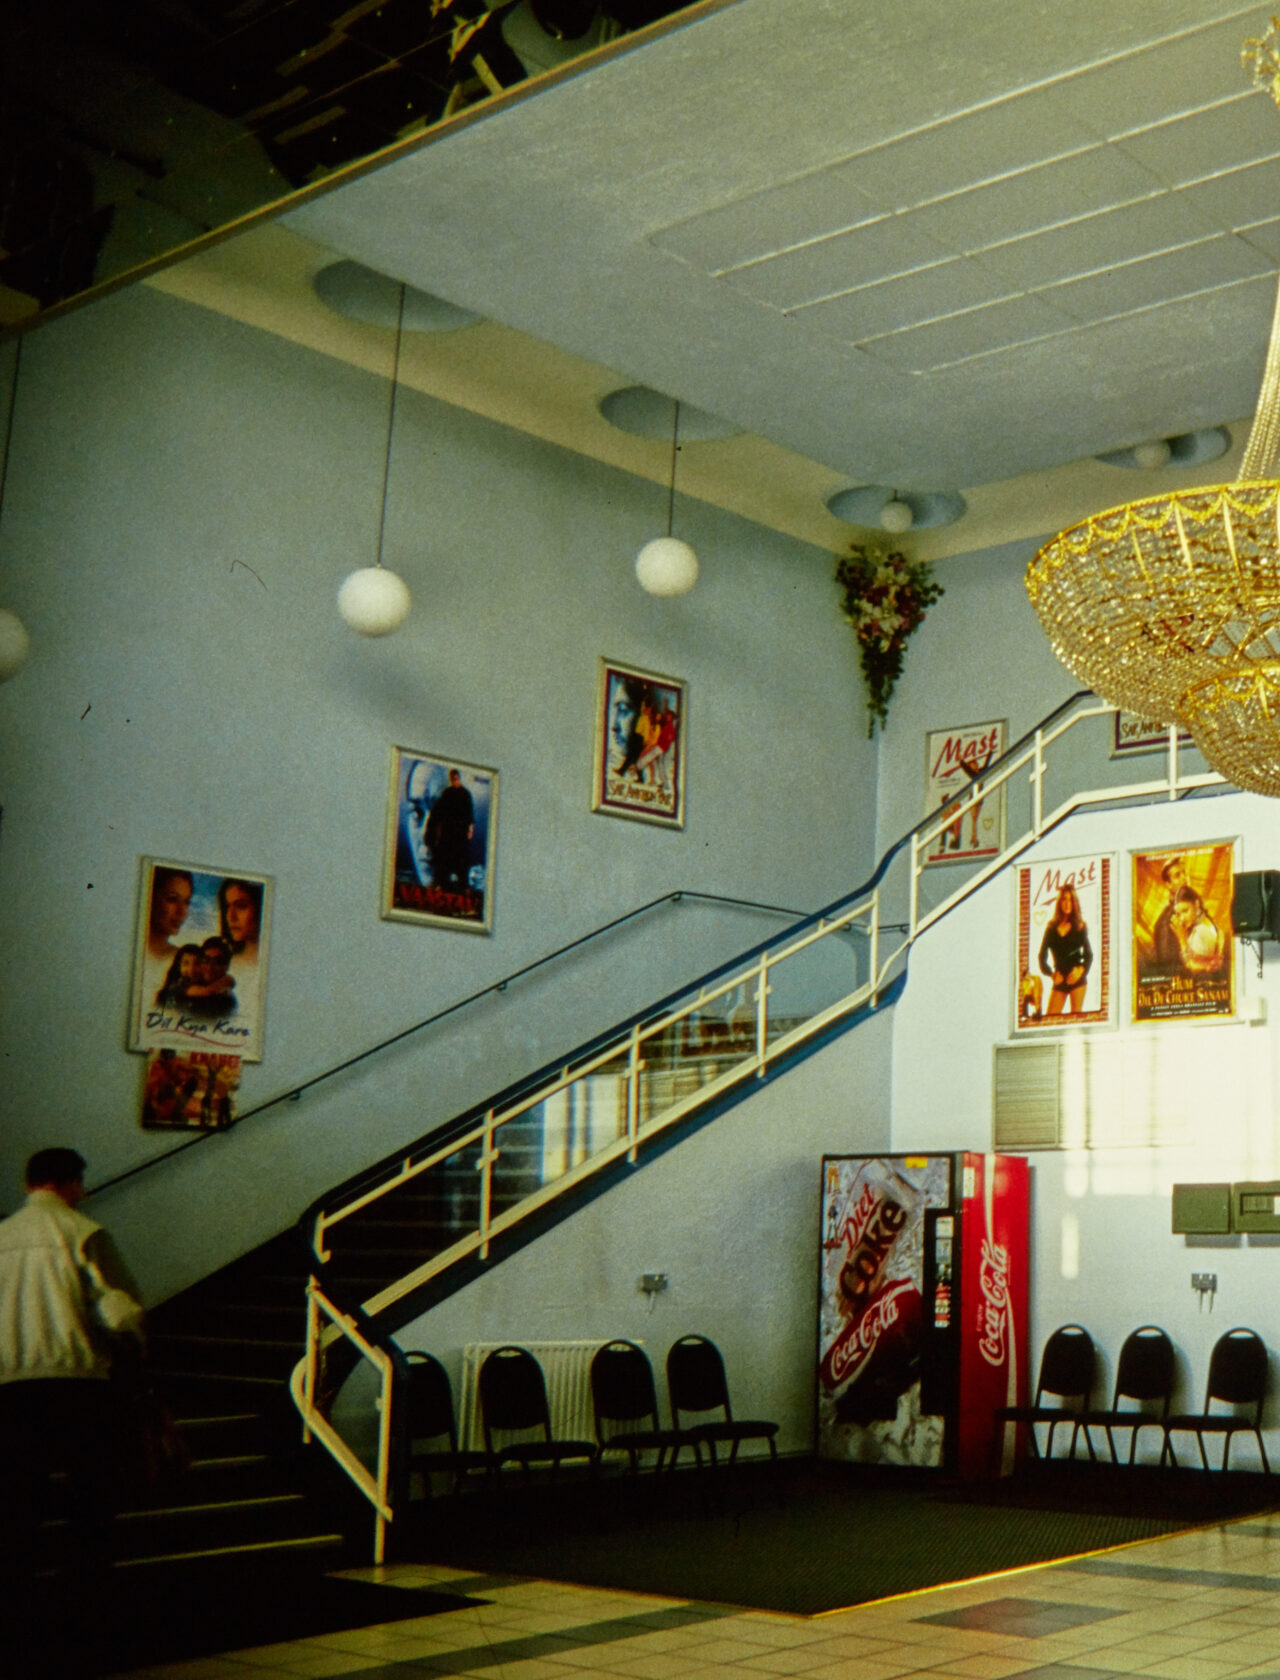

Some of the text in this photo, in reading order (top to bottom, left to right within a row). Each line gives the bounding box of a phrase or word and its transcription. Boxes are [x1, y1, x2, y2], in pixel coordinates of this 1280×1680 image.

[932, 728, 998, 778] Mast
[1033, 861, 1096, 906] Mast
[841, 1183, 876, 1247] Diet
[840, 1201, 907, 1298] Coke
